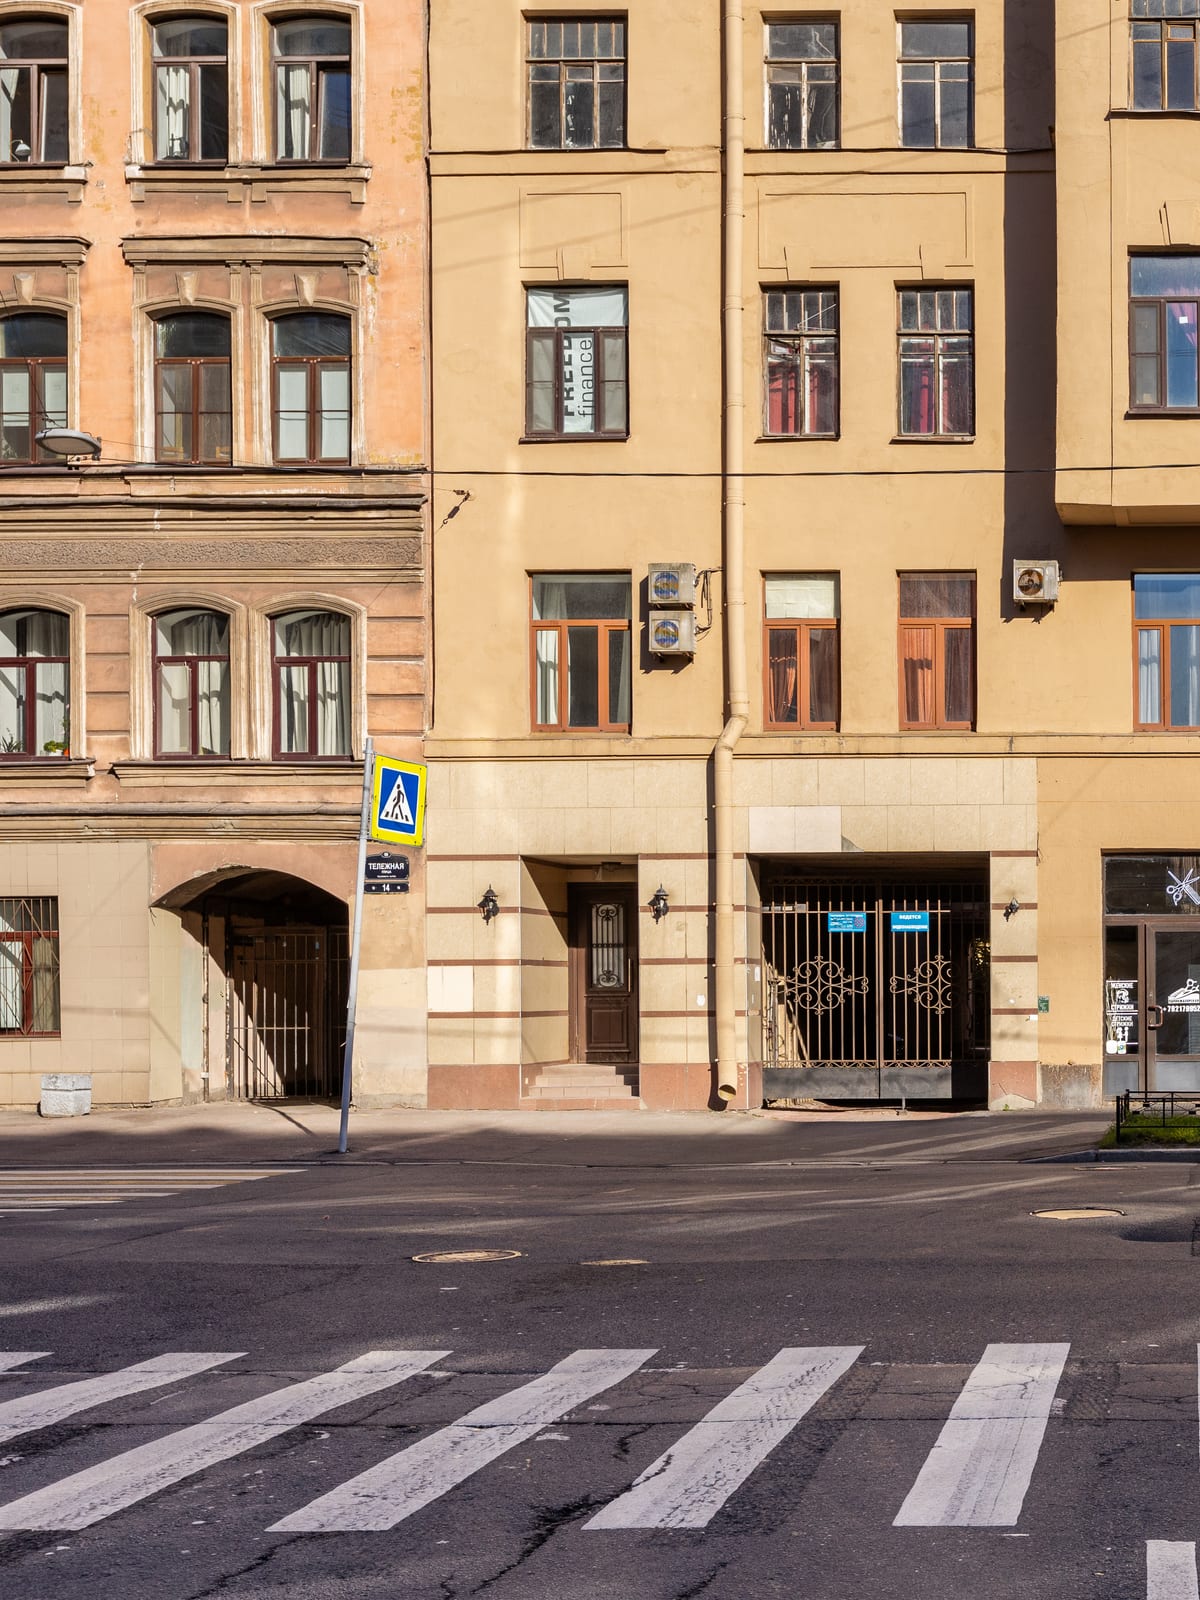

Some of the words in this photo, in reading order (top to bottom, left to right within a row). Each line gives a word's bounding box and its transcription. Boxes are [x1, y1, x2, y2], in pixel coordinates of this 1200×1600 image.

[577, 339, 596, 418] finance
[367, 862, 405, 870] ТЕЛЕЖНАЯ
[382, 883, 390, 892] 14
